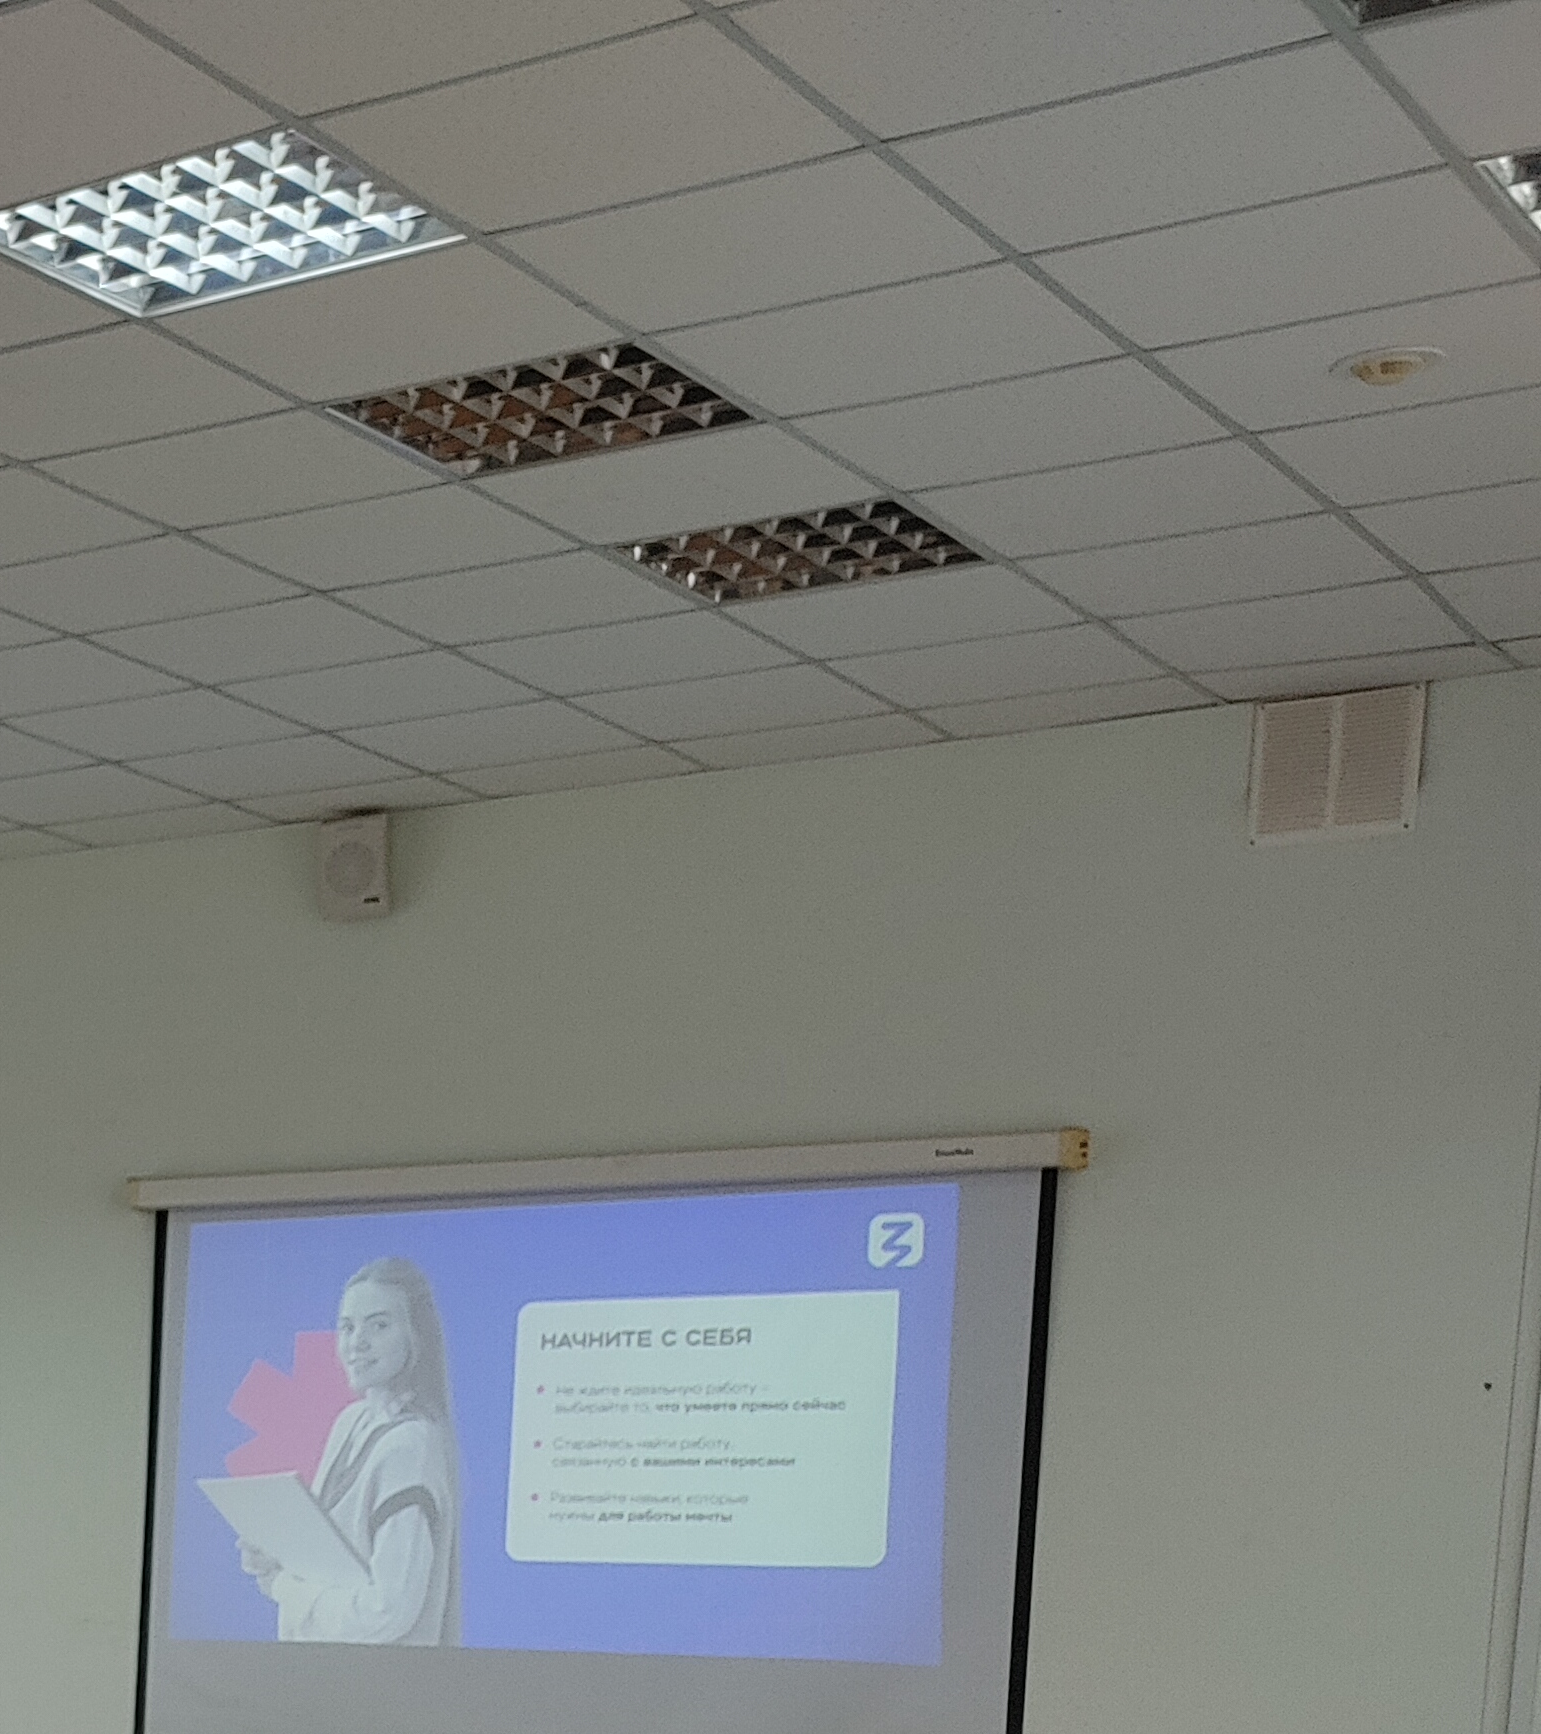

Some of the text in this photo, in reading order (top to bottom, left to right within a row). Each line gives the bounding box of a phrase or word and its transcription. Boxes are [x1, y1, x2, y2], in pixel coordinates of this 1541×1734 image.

[540, 1327, 752, 1350] НАЧНИТЕ С СЕБЯ
[792, 1398, 846, 1411] сейчас
[627, 1508, 681, 1523] работы
